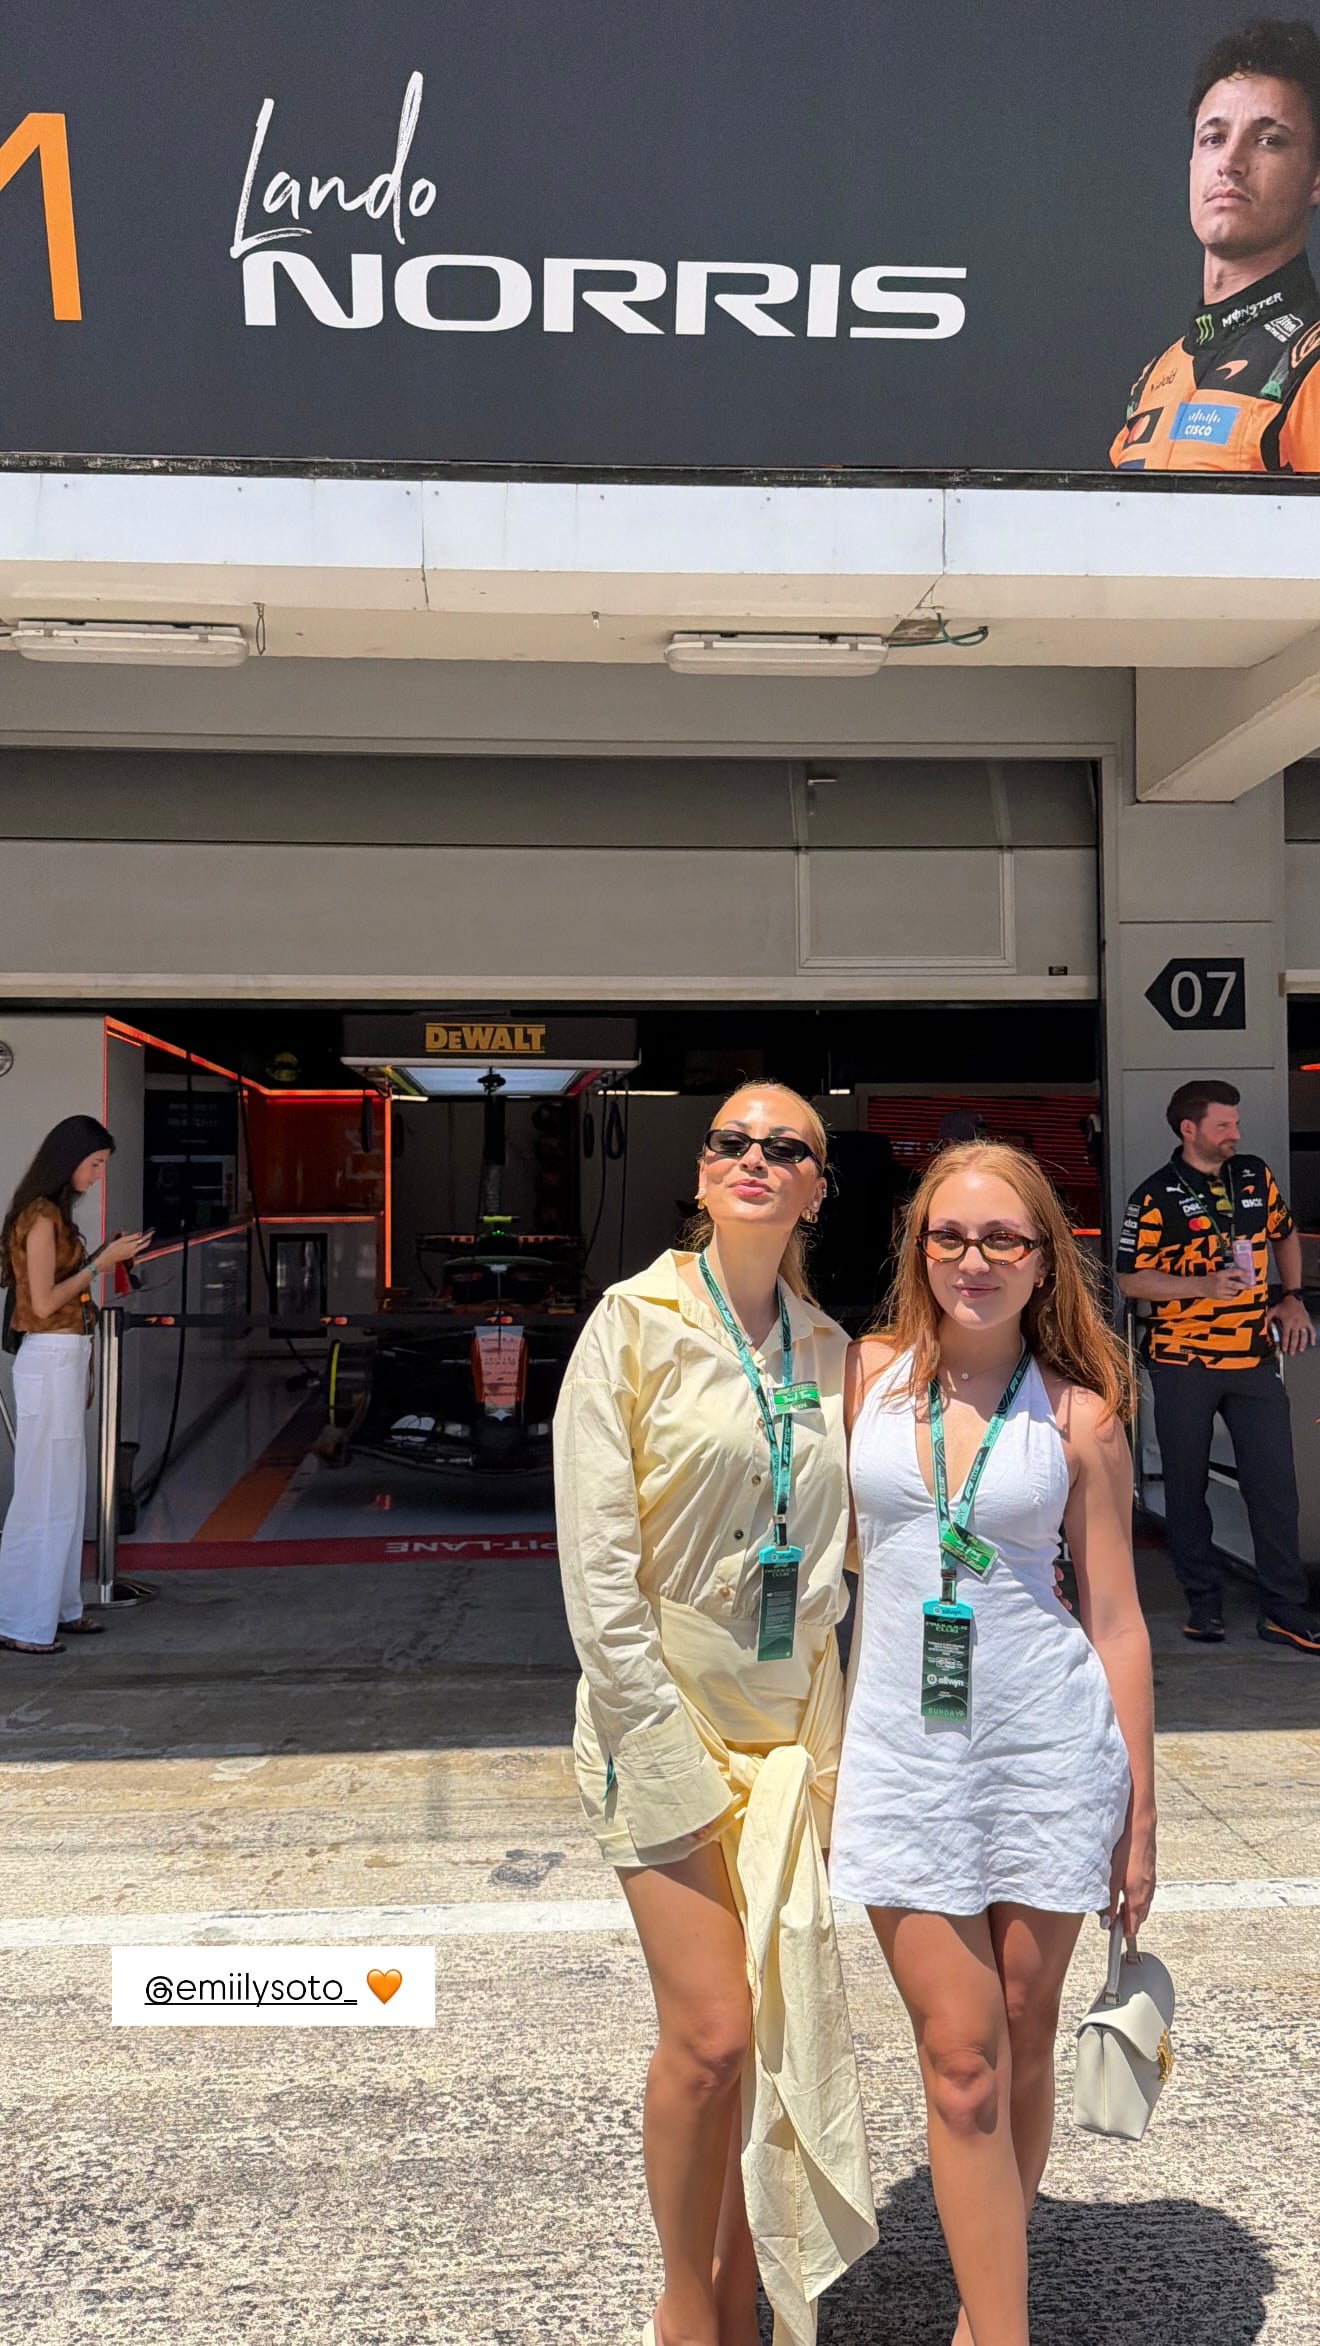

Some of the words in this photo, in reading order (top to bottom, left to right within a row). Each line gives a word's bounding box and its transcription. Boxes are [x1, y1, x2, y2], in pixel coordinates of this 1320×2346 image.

[230, 70, 437, 259] Lando
[242, 250, 968, 340] NORRIS
[1221, 291, 1284, 328] MONSTER
[1184, 424, 1213, 437] CISCO
[1170, 970, 1237, 1018] 07
[938, 1675, 964, 1688] allwyn
